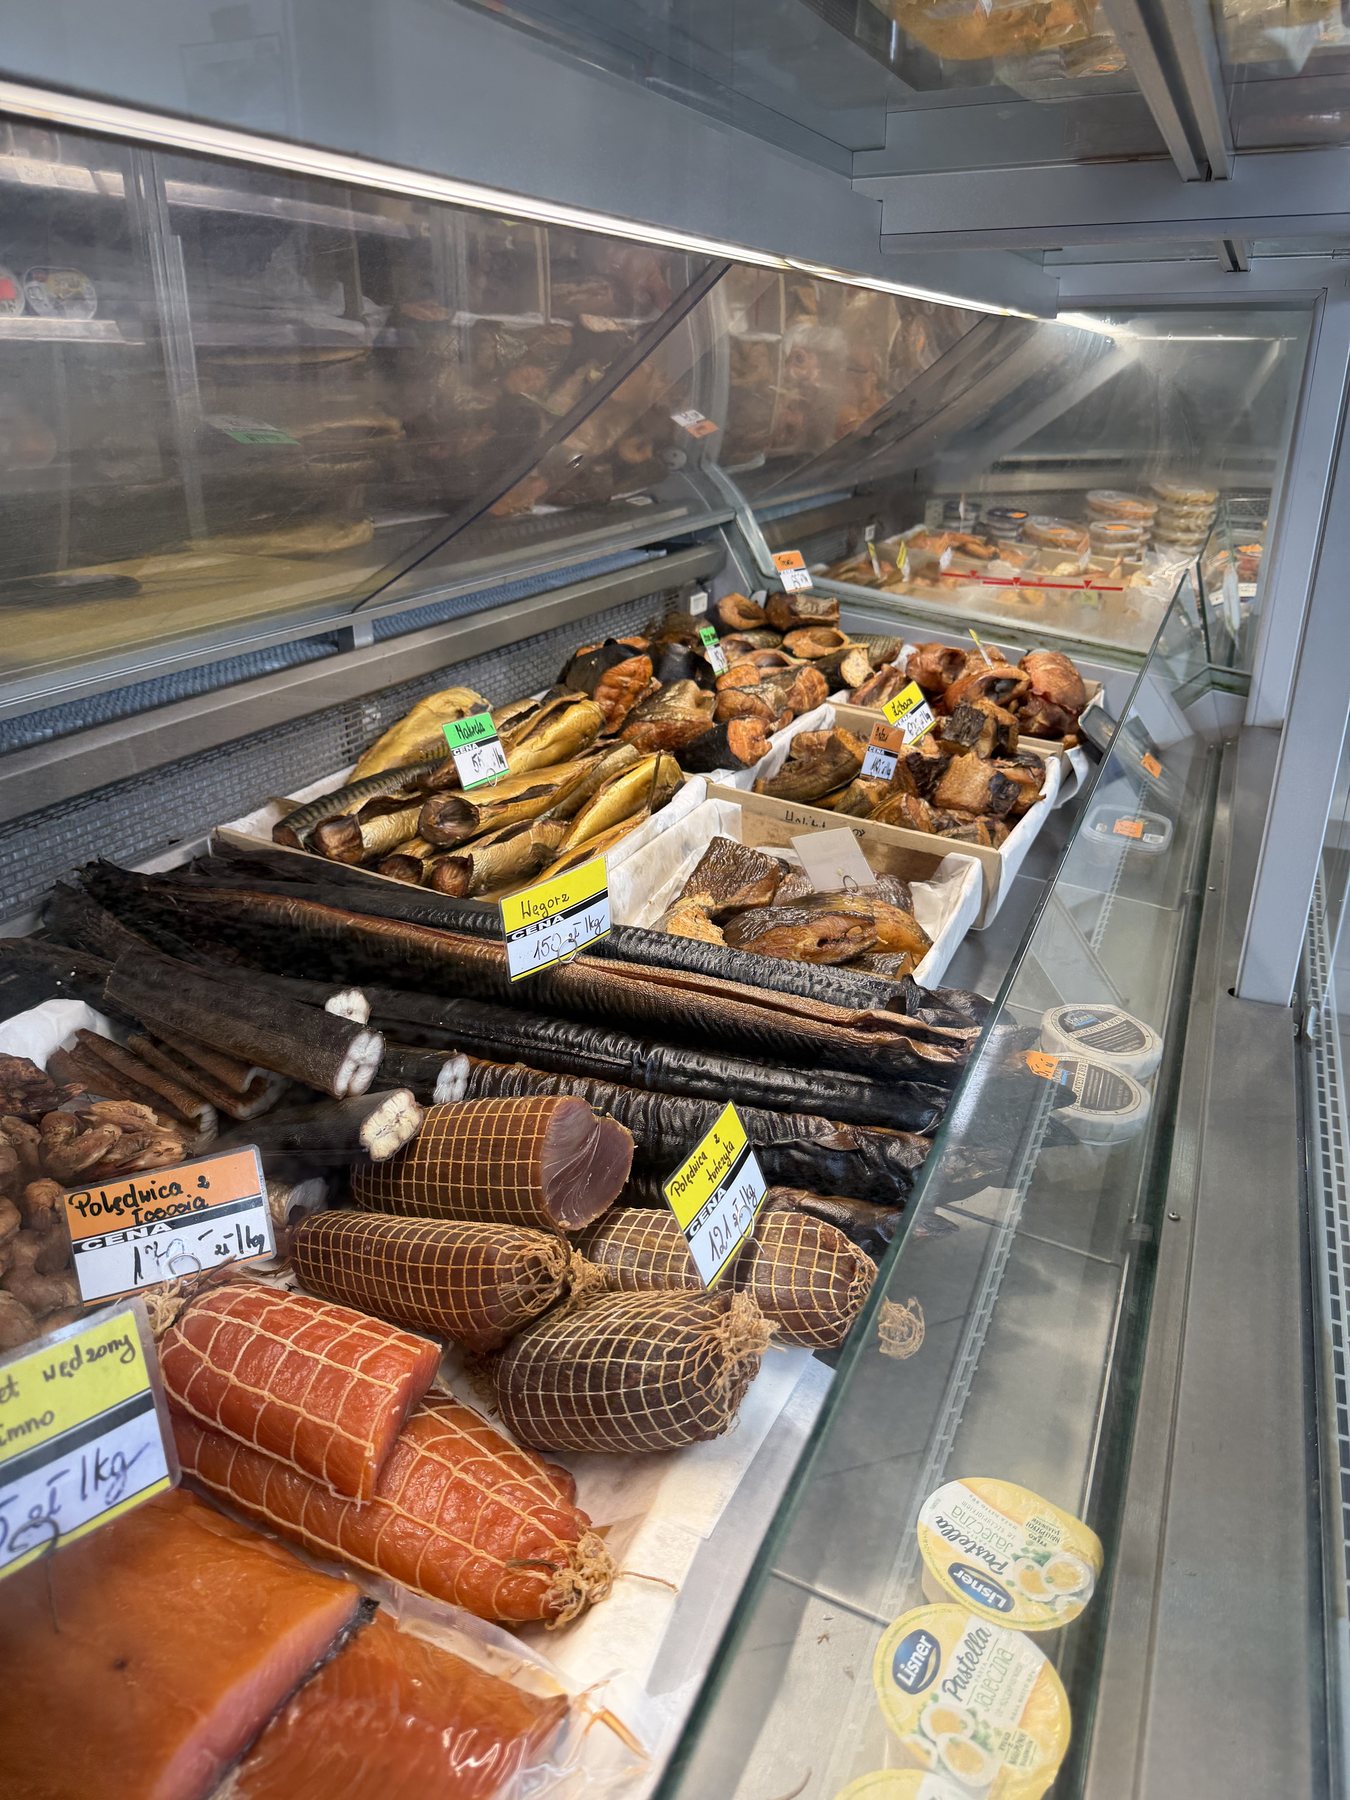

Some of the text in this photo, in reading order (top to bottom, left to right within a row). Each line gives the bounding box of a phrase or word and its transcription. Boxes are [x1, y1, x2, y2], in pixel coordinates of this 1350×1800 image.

[453, 743, 479, 756] CENA
[511, 914, 566, 941] CENA
[81, 1222, 173, 1250] CENA
[689, 1187, 728, 1237] CENA
[42, 1334, 135, 1382] wędzony
[935, 1515, 1009, 1576] Pastella
[953, 1569, 1008, 1609] Lisner
[897, 1635, 933, 1686] Lisner
[942, 1627, 992, 1702] Pastella
